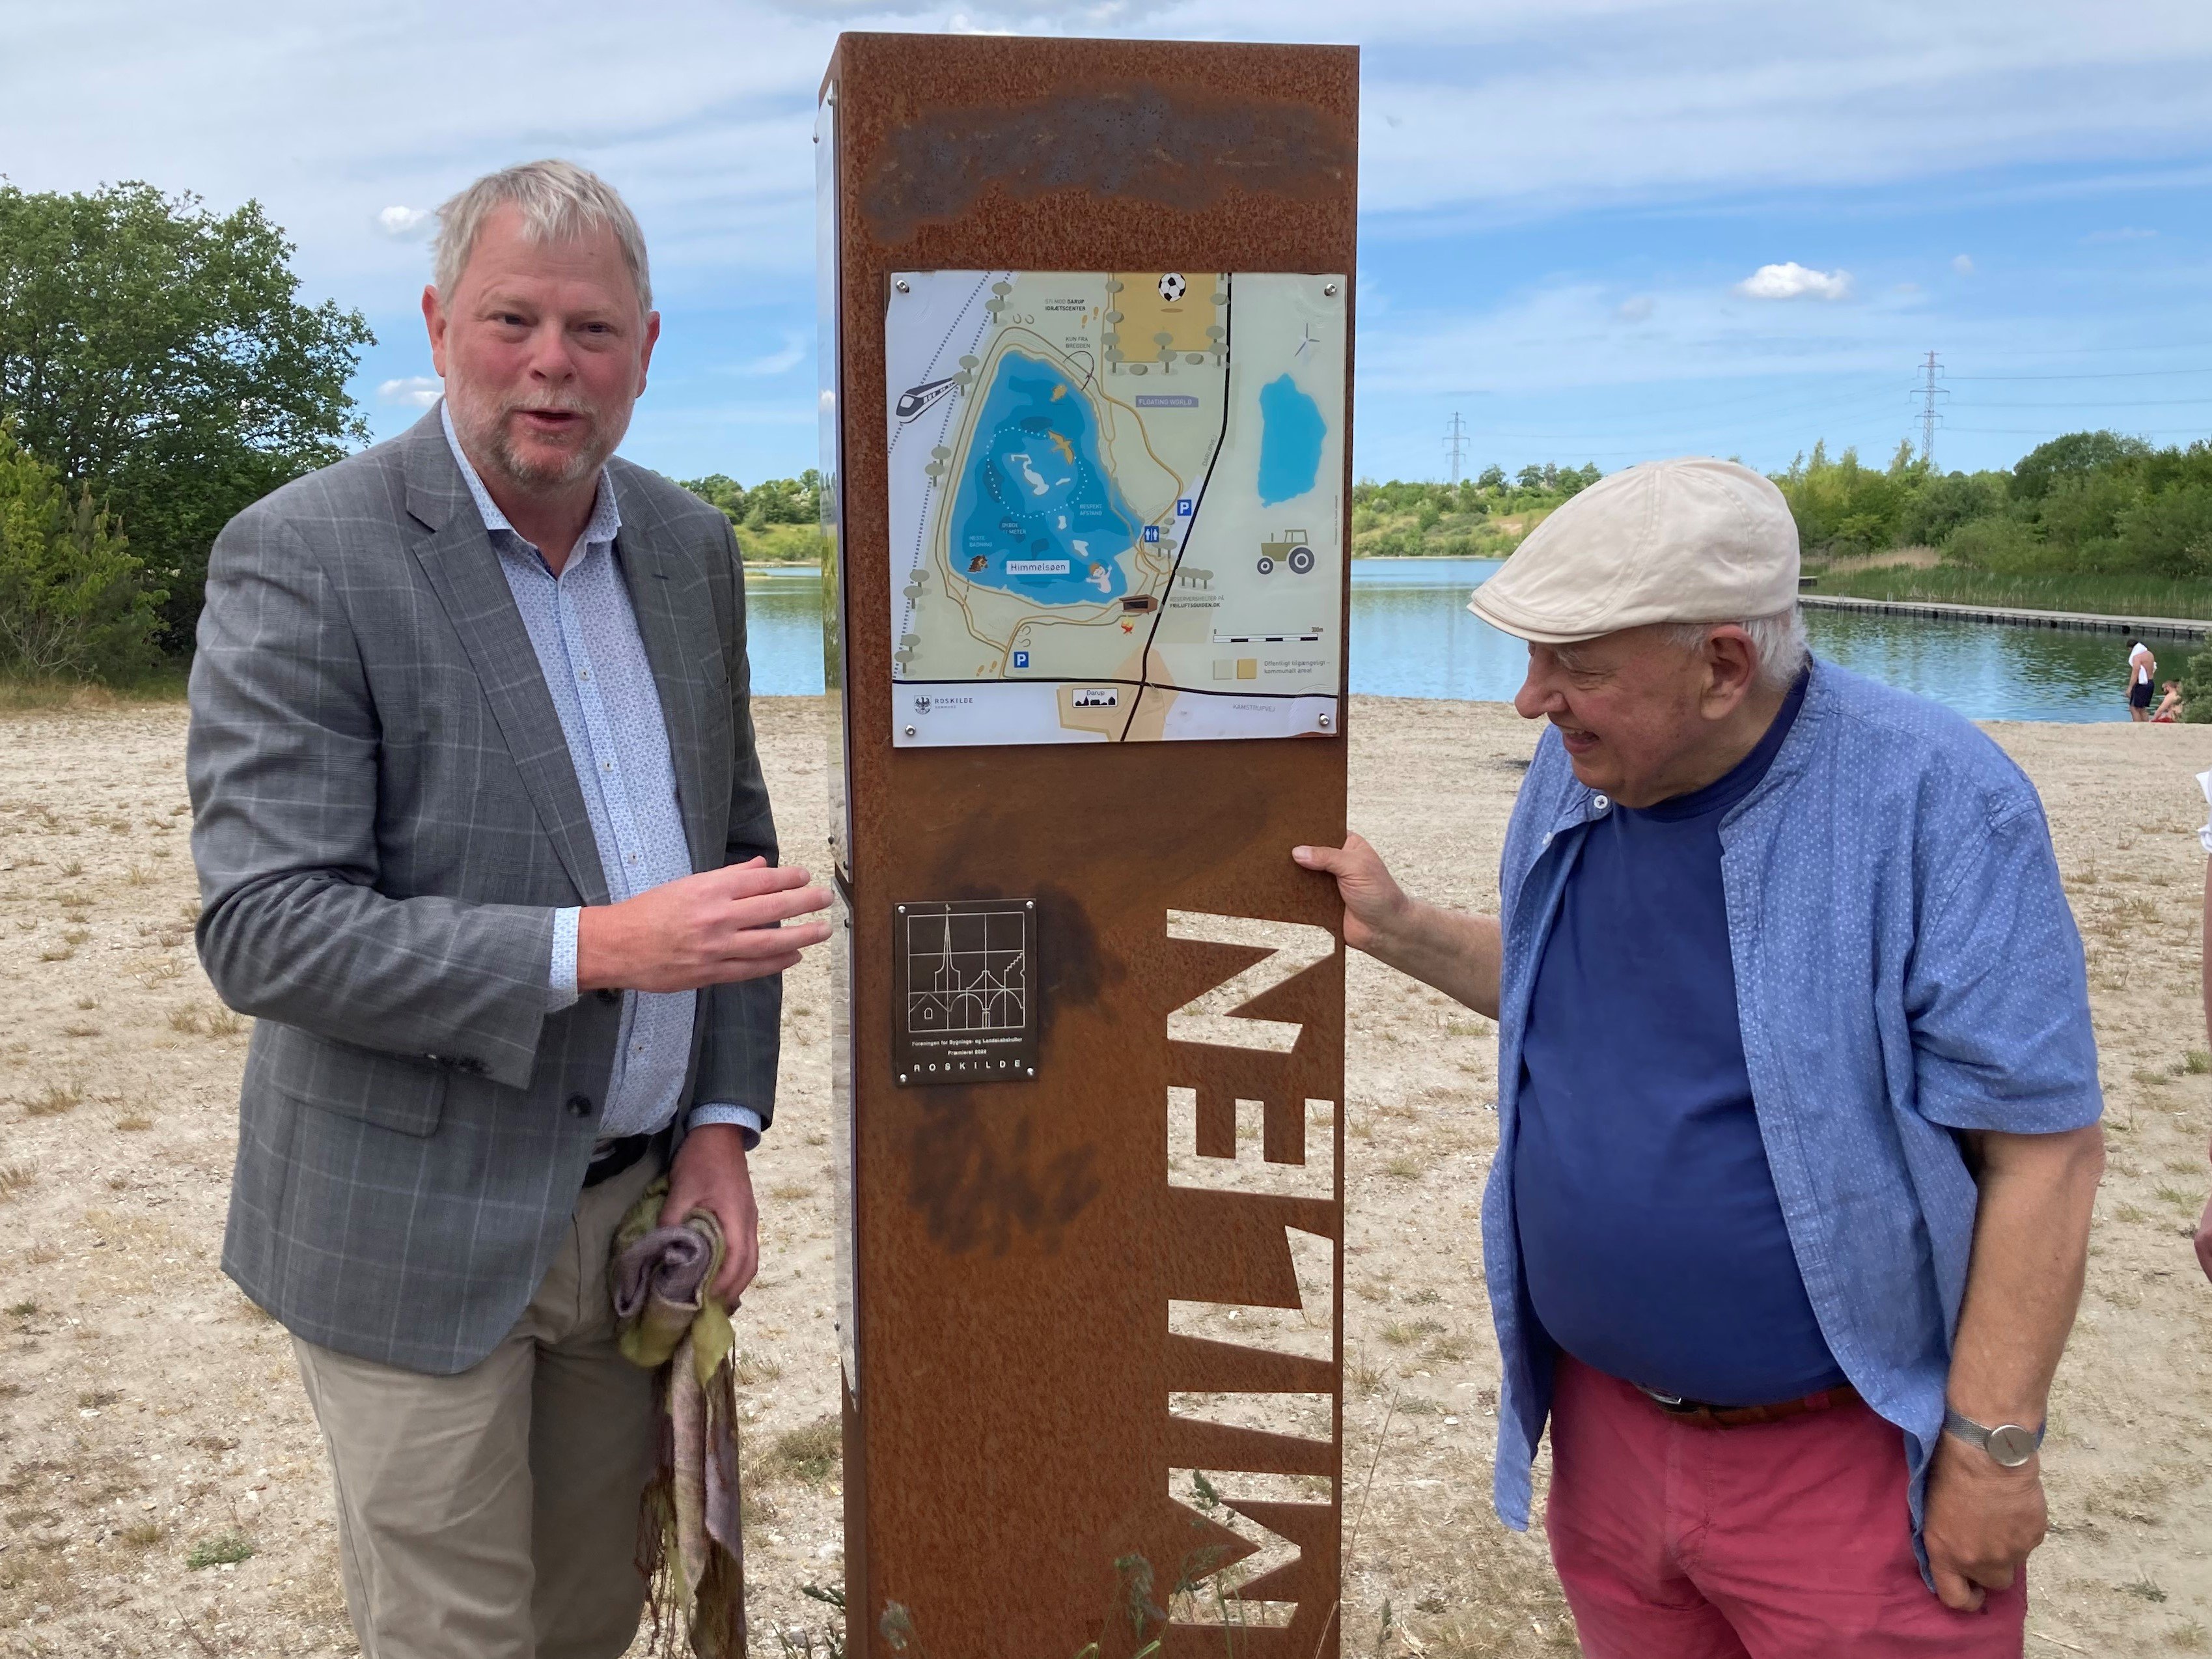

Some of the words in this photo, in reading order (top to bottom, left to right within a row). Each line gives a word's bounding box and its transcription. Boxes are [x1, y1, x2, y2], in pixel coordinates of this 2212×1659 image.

[1202, 434, 1218, 467] DARUPVEJ
[1180, 502, 1189, 514] P
[1010, 563, 1066, 572] Himmelsøen
[1017, 654, 1027, 666] P
[1232, 704, 1277, 713] KAMSTRUPVEJ
[913, 1059, 1021, 1072] ROSKILDE
[1167, 908, 1336, 1630] MILEN
